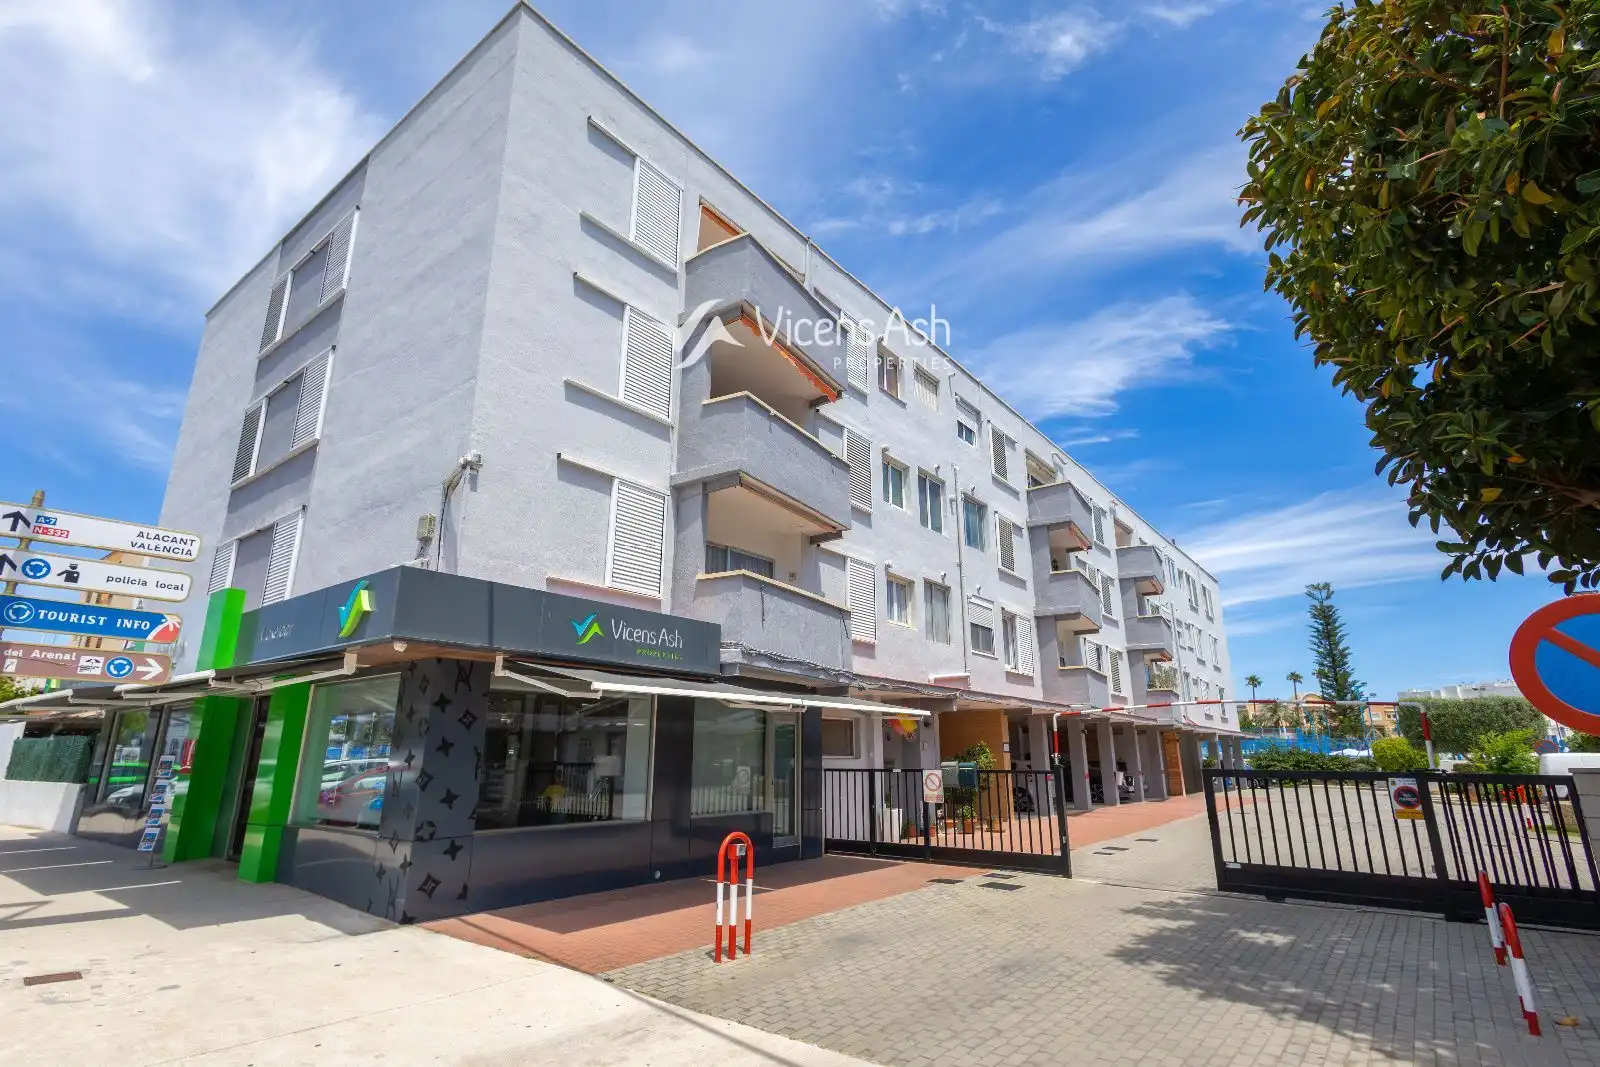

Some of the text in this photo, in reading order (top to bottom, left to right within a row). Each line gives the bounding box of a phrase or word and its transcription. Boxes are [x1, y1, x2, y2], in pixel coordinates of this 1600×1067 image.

[36, 516, 56, 525] A-7
[34, 526, 69, 538] N-332
[136, 530, 196, 547] ALACANT
[155, 580, 184, 592] local
[37, 609, 151, 630] TOURIST INFO
[611, 618, 683, 649] Vicens Ash
[3, 648, 77, 661] del Arenal
